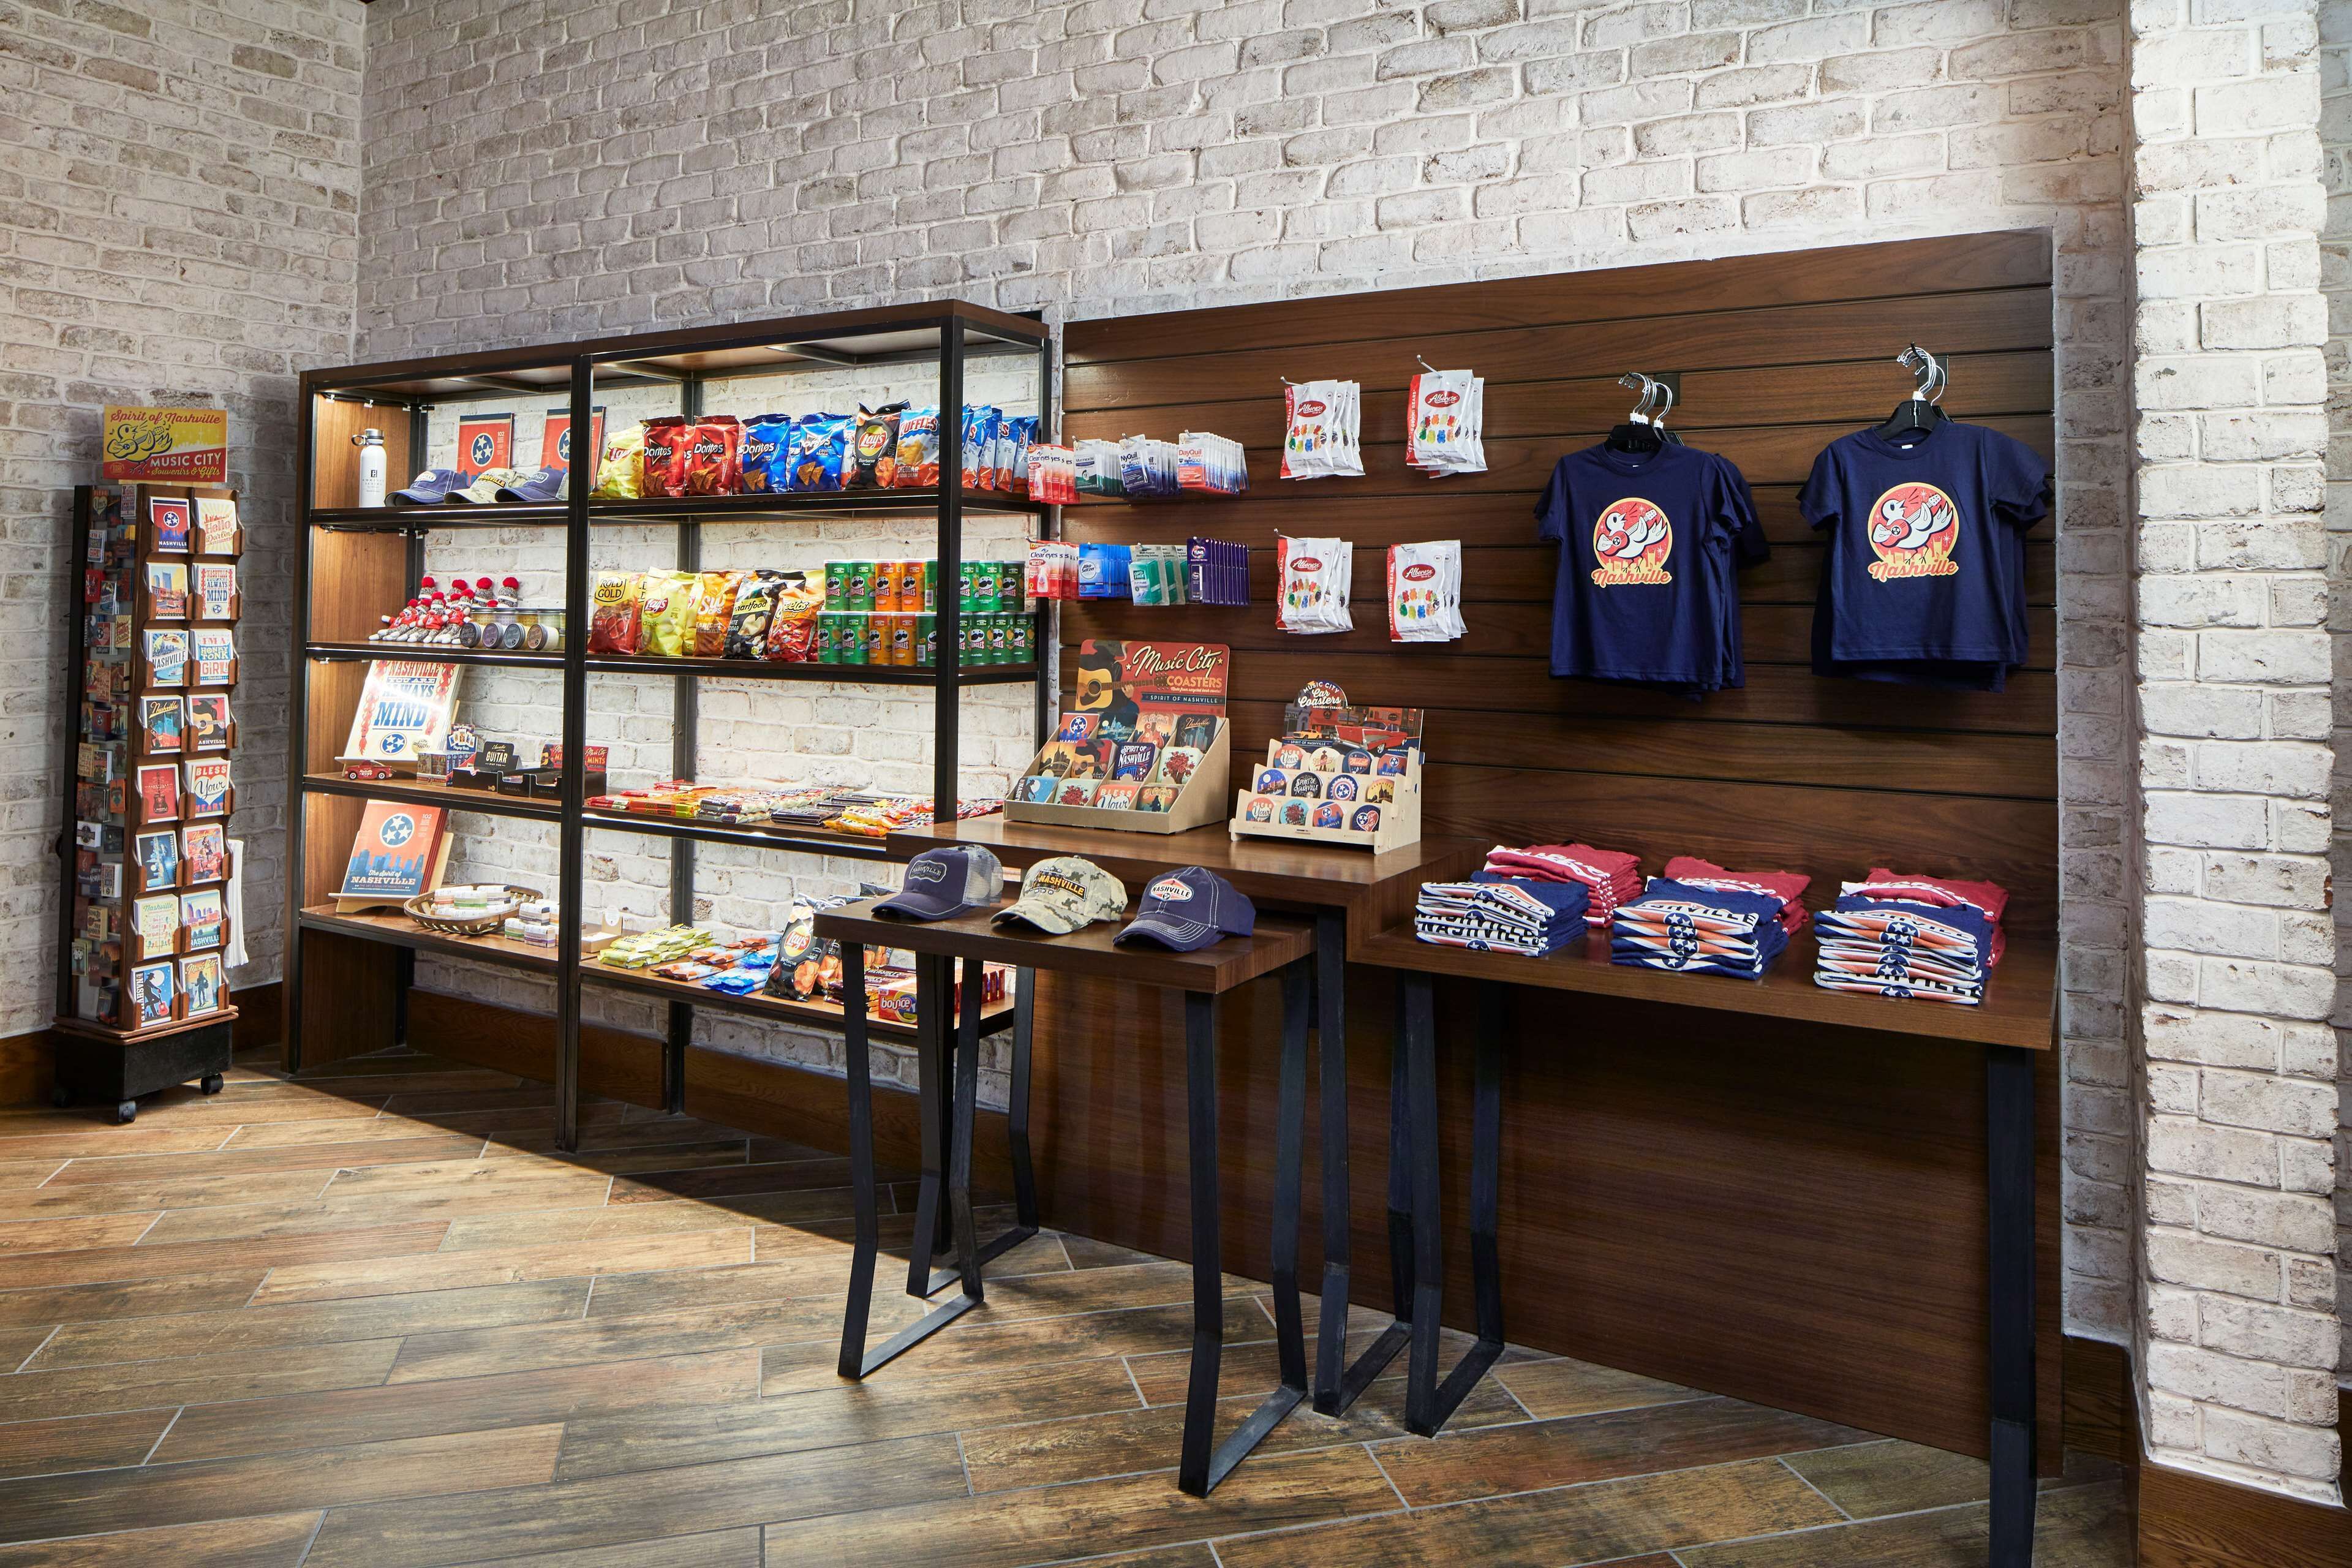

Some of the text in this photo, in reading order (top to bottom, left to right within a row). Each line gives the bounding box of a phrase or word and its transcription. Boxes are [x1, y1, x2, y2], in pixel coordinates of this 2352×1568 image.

[1428, 394, 1458, 403] Albanese
[1298, 404, 1324, 413] Albanese
[111, 410, 221, 425] Spirit of Nashville
[859, 432, 885, 449] Lay's
[694, 443, 723, 454] Doritos
[1178, 448, 1202, 457] DayQuil
[150, 452, 222, 467] MUSIC CITY
[1120, 452, 1138, 462] NyQuil
[151, 466, 221, 478] Souvenirs & Gifts
[205, 520, 232, 533] Hello
[206, 527, 233, 543] Darlin!
[1292, 559, 1319, 568] Albanese
[206, 570, 228, 578] NASHVILLE
[1405, 567, 1433, 578] Albanese
[1868, 558, 1959, 583] Nashville
[1591, 568, 1672, 589] Nashville
[206, 590, 228, 601] MIND
[598, 589, 622, 598] GOLD
[200, 646, 228, 655] HONKY
[153, 650, 186, 669] NASHVILLE
[1132, 645, 1223, 678] Music City
[388, 661, 441, 677] NASHVILLE
[1166, 676, 1223, 688] COASTERS
[1303, 681, 1340, 693] MUSIC CITY
[1311, 688, 1330, 698] Car
[1298, 696, 1341, 707] Coasters
[149, 700, 179, 718] Nashville
[374, 701, 429, 727] MIND
[1185, 717, 1211, 728] Nashville
[486, 751, 508, 763] GUITAR
[586, 747, 607, 757] Music City
[1118, 751, 1150, 767] NASHVILLE
[195, 765, 227, 777] BLESS
[194, 778, 226, 801] Your
[1100, 788, 1133, 797] BLESS
[1294, 784, 1319, 794] NASHVILLE
[195, 803, 224, 812] HEART
[1101, 797, 1128, 810] Your
[191, 829, 218, 842] Nashville
[911, 865, 941, 876] NASHVILLE
[350, 876, 416, 885] NASHVILLE
[1039, 875, 1085, 897] NASHVILLE
[1151, 884, 1193, 899] NASHVILLE
[143, 902, 174, 912] Nashville
[786, 930, 807, 948] Lay's
[780, 957, 797, 966] Barbecue
[186, 963, 206, 975] Music
[881, 996, 911, 1009] bounce
